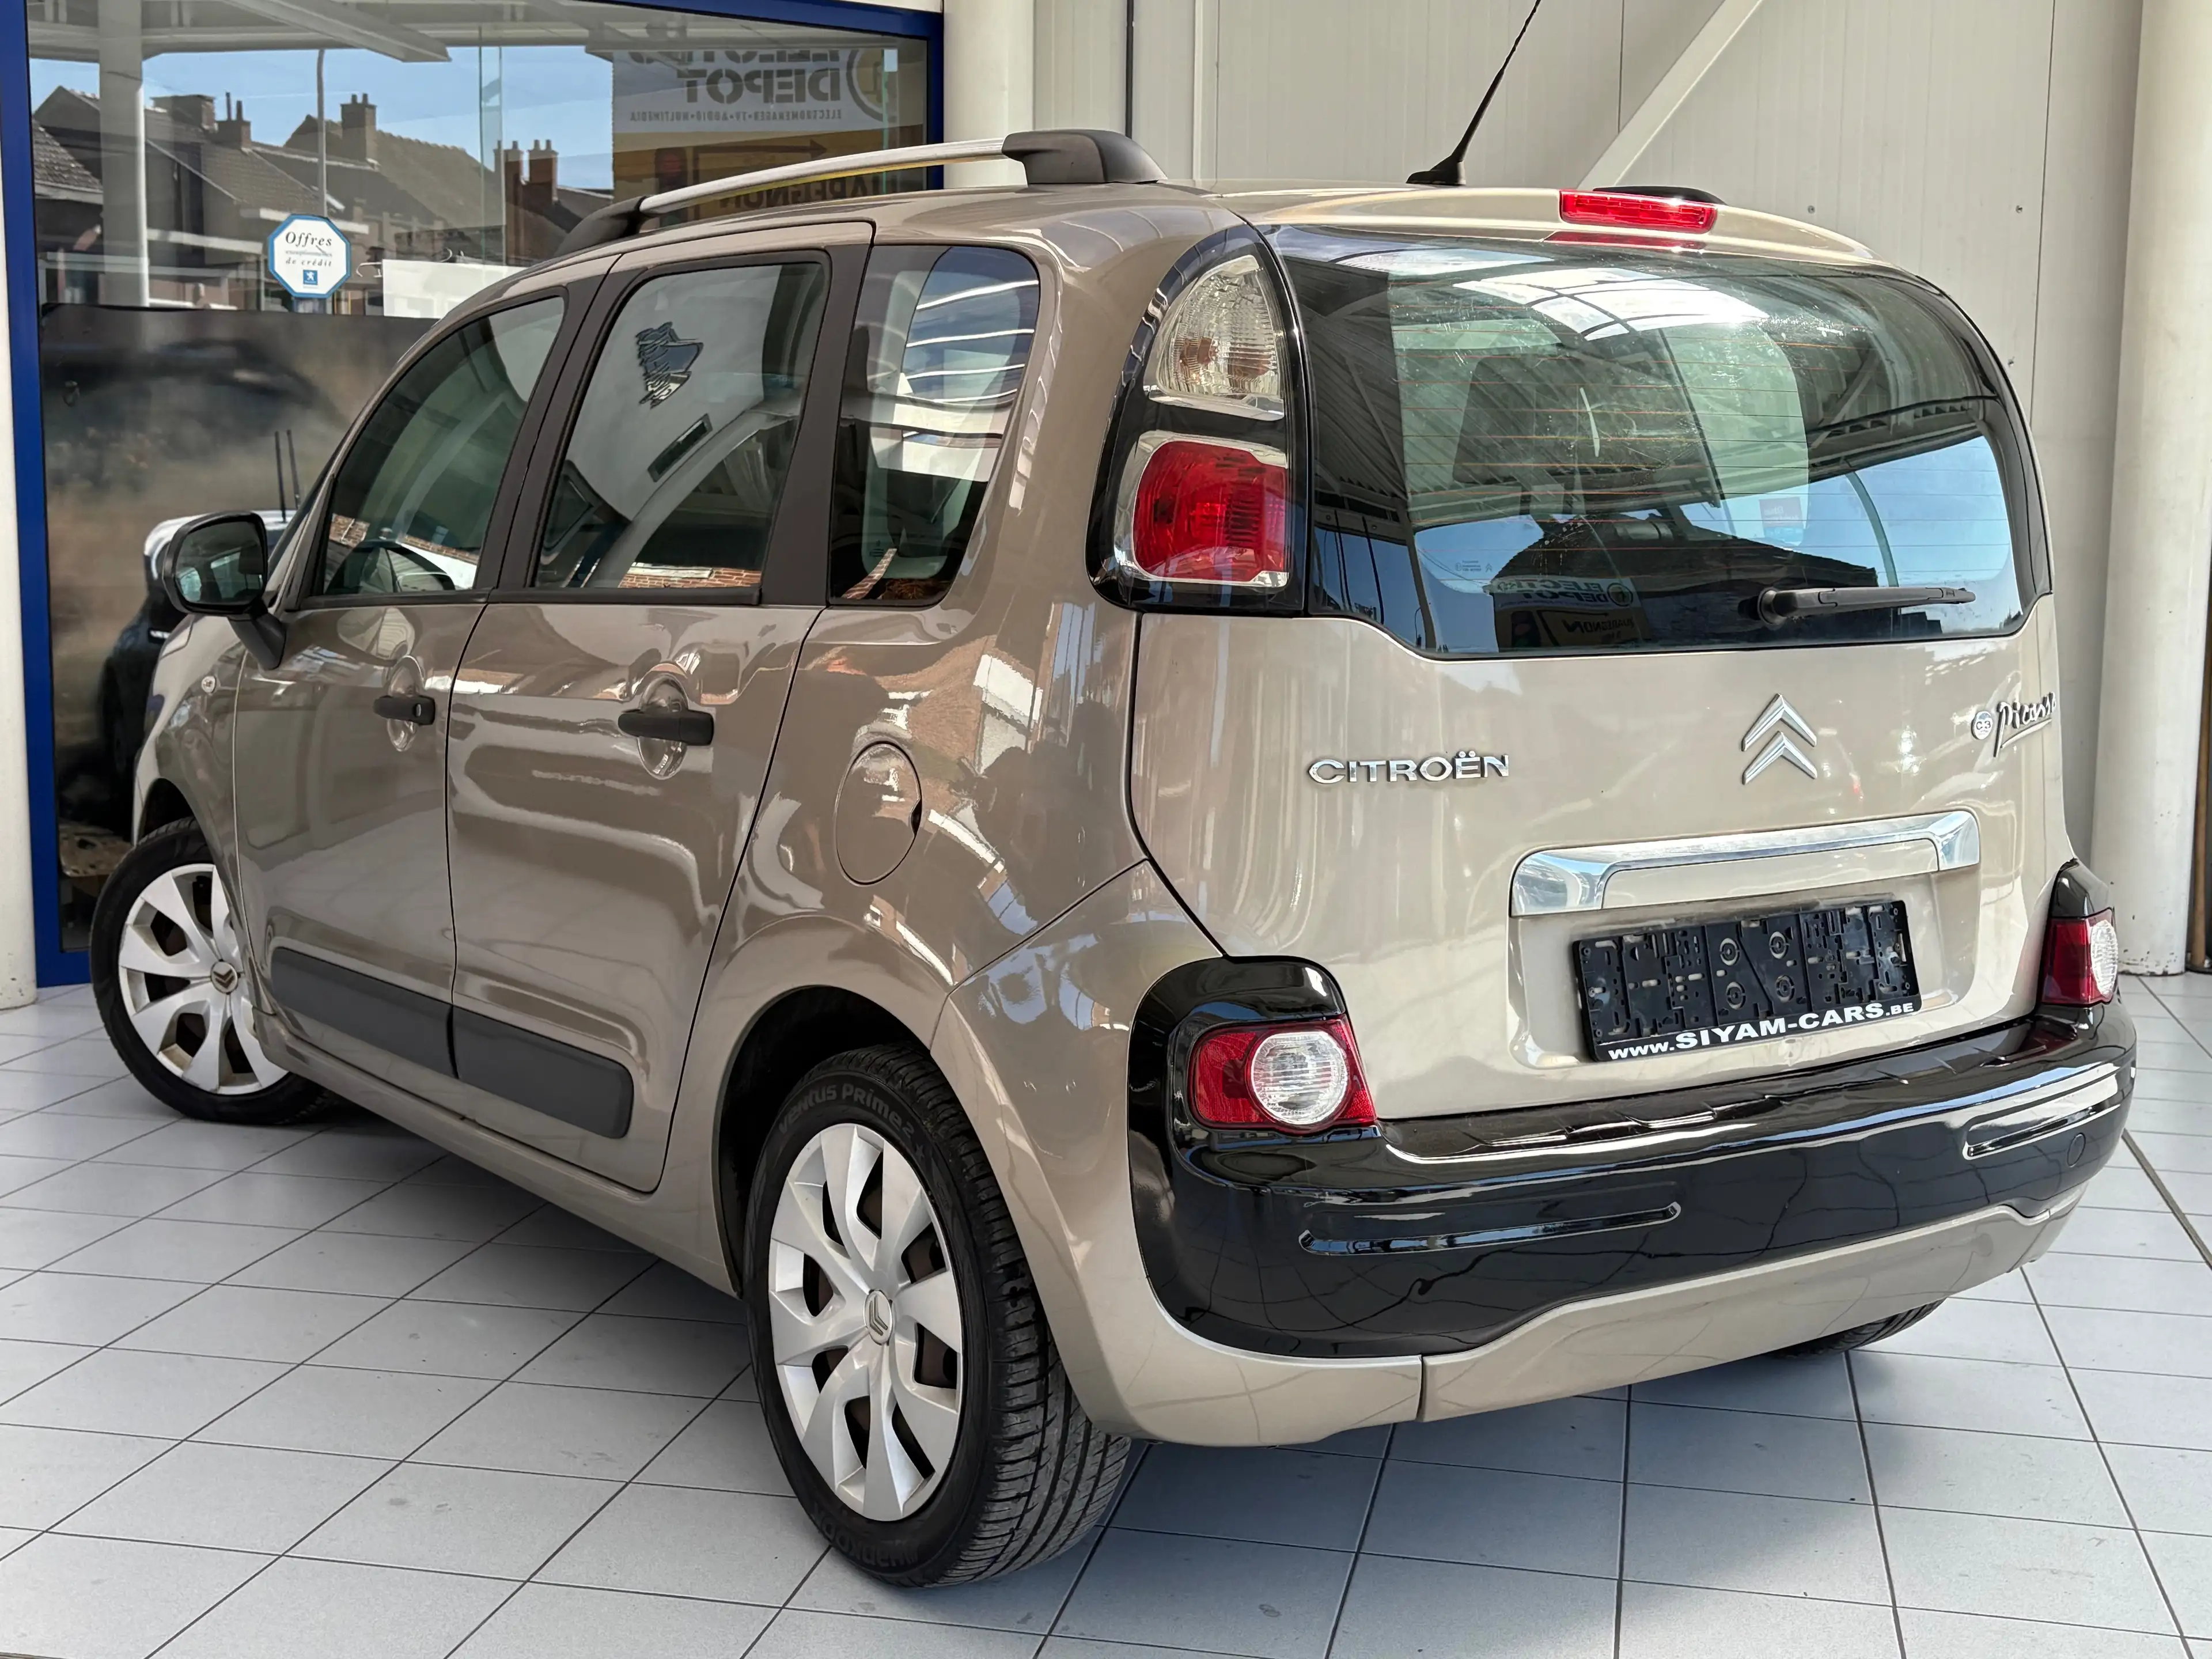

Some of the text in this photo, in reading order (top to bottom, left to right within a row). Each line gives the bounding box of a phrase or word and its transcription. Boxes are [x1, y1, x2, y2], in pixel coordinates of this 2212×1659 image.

[285, 231, 332, 248] Offres
[285, 257, 332, 267] de crédit
[1308, 750, 1510, 784] CITROËN
